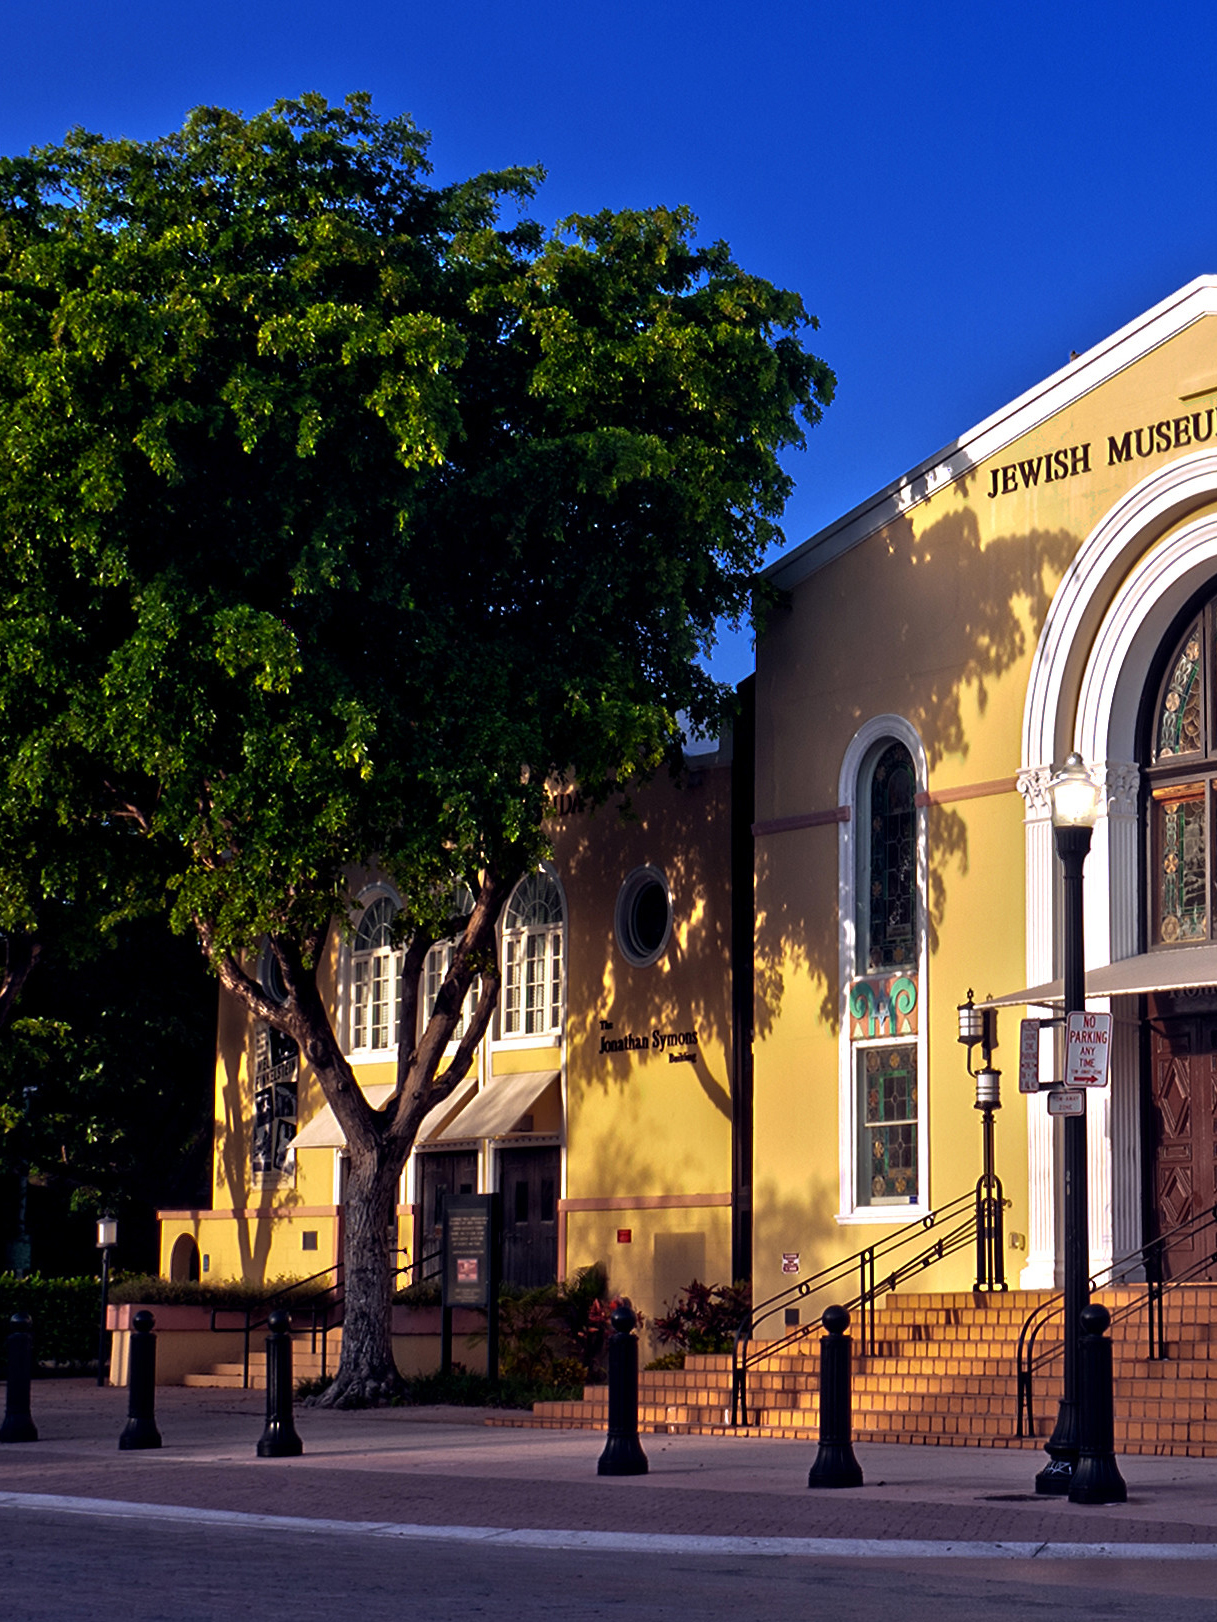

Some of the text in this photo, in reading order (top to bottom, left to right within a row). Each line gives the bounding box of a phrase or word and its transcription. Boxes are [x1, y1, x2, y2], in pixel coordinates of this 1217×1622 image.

[988, 443, 1090, 498] JEWISH
[1083, 1015, 1096, 1028] NO
[599, 1030, 698, 1054] Jonathan Symons
[1069, 1030, 1108, 1044] PARKING
[1080, 1046, 1096, 1056] ANY
[1080, 1058, 1096, 1068] TIME
